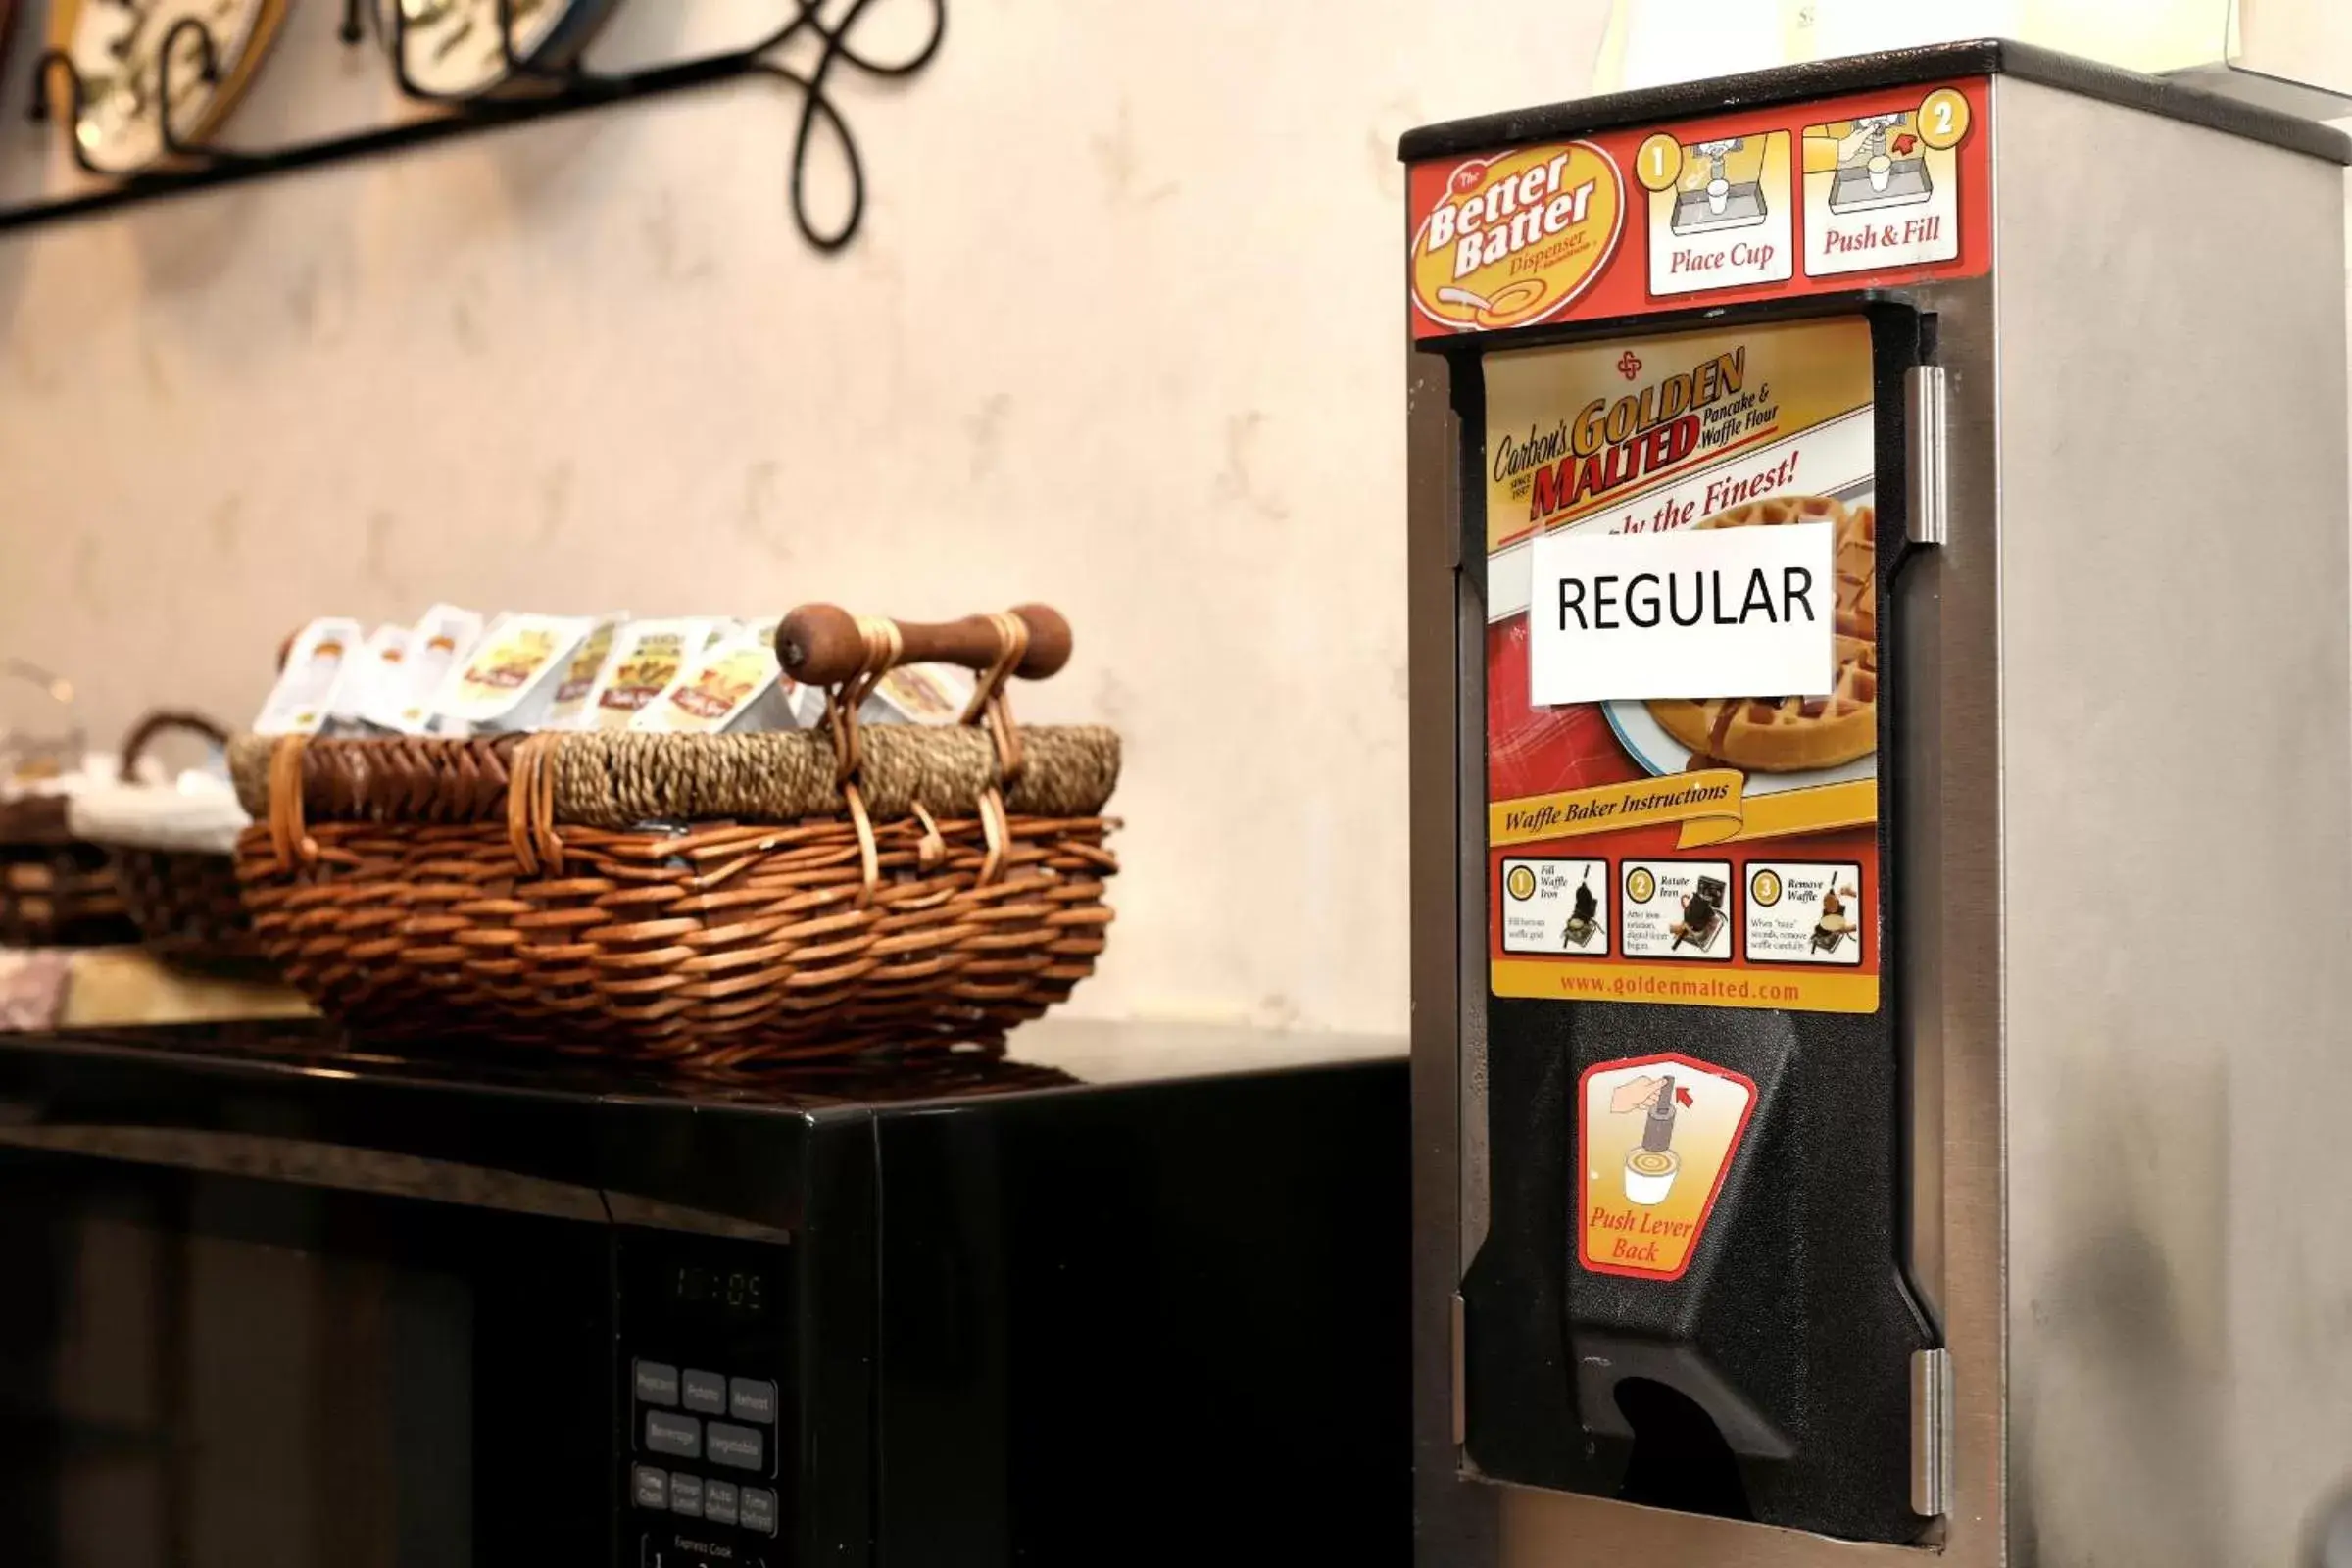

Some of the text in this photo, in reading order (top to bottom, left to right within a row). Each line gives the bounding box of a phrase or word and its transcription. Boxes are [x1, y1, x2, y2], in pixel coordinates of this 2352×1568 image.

[1934, 102, 1953, 135] 2
[1651, 147, 1664, 176] 1
[1459, 172, 1479, 185] The
[1427, 152, 1569, 253] Better
[1453, 180, 1596, 280] Batter
[1824, 215, 1941, 255] Push & Fill
[1509, 231, 1586, 275] Dispenser
[1671, 242, 1775, 274] Place Cup
[1494, 345, 1745, 482] Carbon's GOLDEN
[1703, 382, 1770, 426] Pancake &
[1701, 405, 1780, 449] Waffle Flour
[1529, 414, 1701, 522] MALTED
[1652, 498, 1695, 533] the
[1700, 450, 1799, 516] Finest!
[1558, 566, 1815, 631] REGULAR
[1505, 783, 1730, 833] Waffle Baker Instructions
[1516, 872, 1526, 892] 1
[1540, 876, 1568, 888] Waffle
[1541, 865, 1555, 875] Fill
[1635, 874, 1645, 893] 2
[1660, 875, 1690, 886] Rotate
[1788, 879, 1824, 890] Remove
[1540, 889, 1558, 899] Iron
[1659, 888, 1679, 898] Iron
[1760, 877, 1772, 897] 3
[1788, 891, 1819, 903] Waffle
[1560, 976, 1800, 1000] www.goldenmalted.com
[1589, 1206, 1694, 1238] Push Lever
[1612, 1238, 1660, 1262] Back
[709, 1542, 733, 1559] Cook
